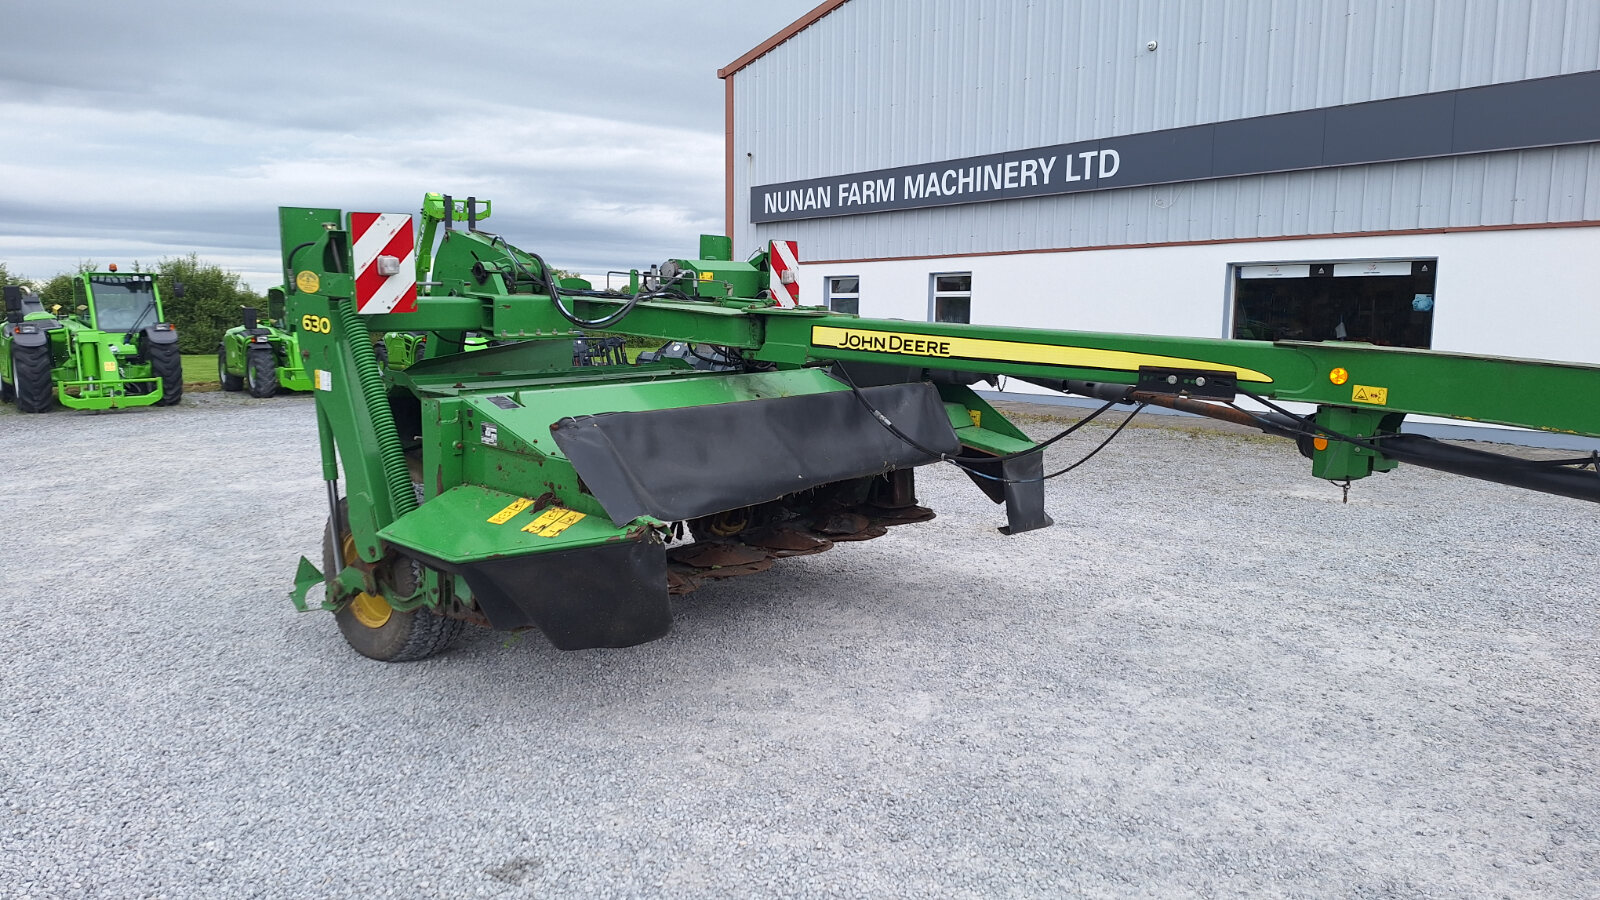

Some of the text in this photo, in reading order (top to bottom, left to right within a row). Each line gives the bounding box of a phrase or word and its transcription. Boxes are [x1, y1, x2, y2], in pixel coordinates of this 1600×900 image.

[764, 149, 1120, 214] NUNAN FARM MACHINERY LTD
[302, 314, 331, 334] 630
[838, 331, 951, 355] JOHN DEERE
